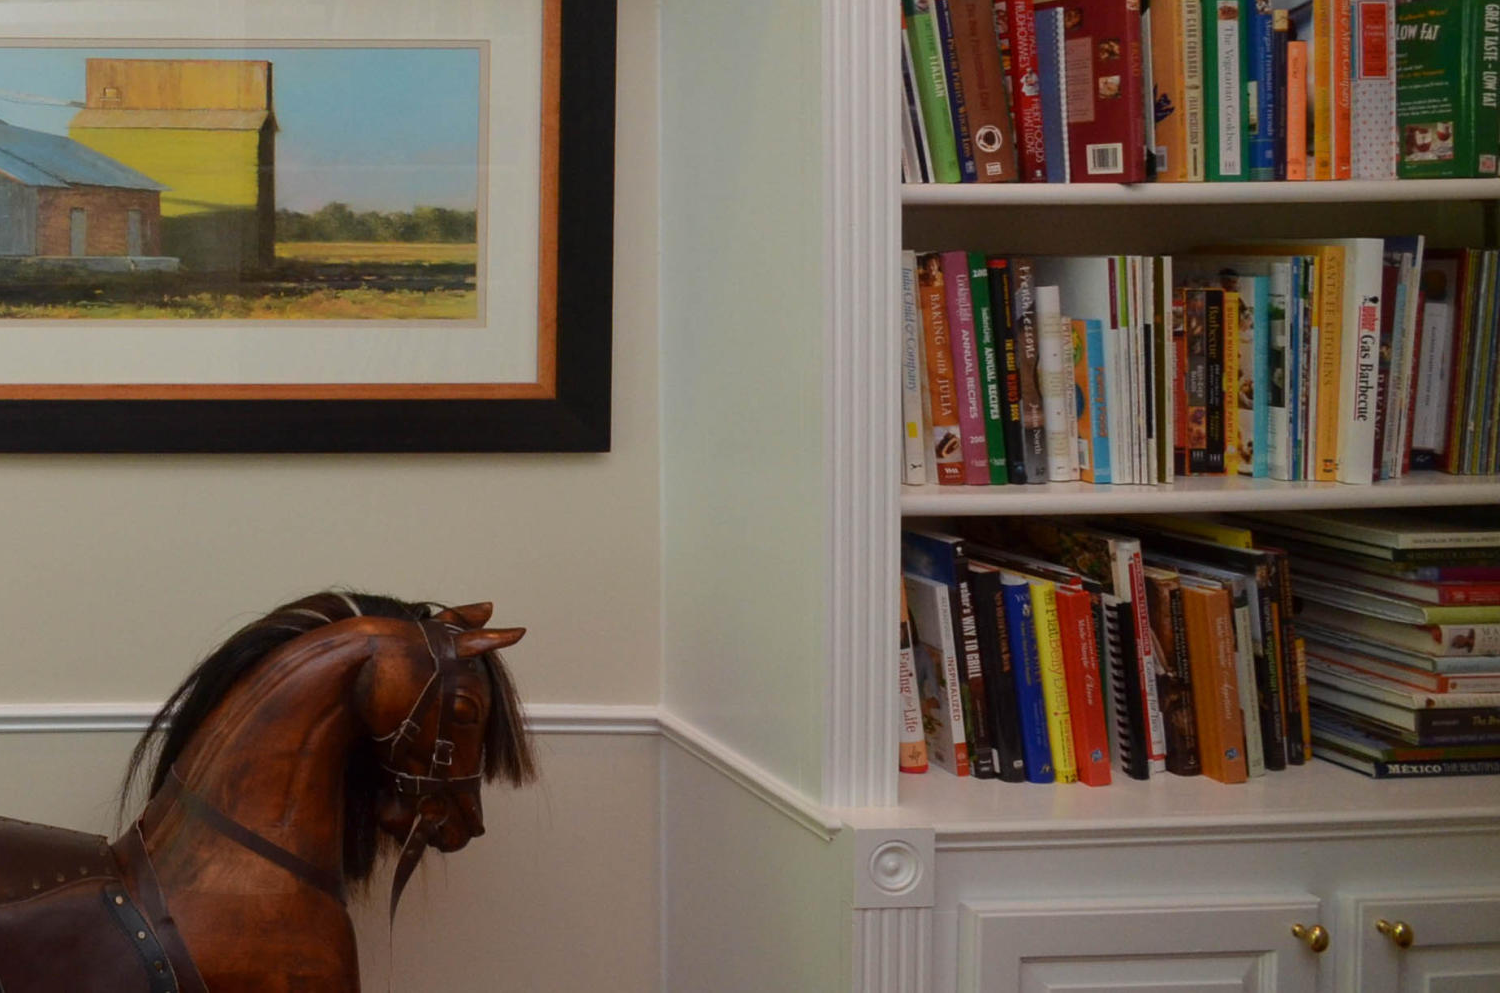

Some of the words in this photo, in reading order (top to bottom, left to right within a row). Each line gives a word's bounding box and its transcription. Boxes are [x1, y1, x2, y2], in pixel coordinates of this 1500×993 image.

[1224, 27, 1235, 46] The
[1396, 23, 1419, 41] LOW
[1420, 21, 1441, 42] FAT
[1484, 3, 1500, 35] GREAT
[1342, 30, 1352, 56] More
[1484, 37, 1499, 63] TASTE
[929, 54, 947, 98] ITALIAN
[1221, 48, 1236, 102] Vegetarian
[1340, 57, 1353, 108] Company
[1482, 70, 1498, 89] LOW
[1481, 90, 1497, 108] FAT
[1034, 125, 1046, 163] FOODS
[1325, 255, 1338, 296] SANTA
[930, 294, 946, 346] BAKING
[1324, 300, 1336, 317] FE
[1022, 313, 1038, 359] Lessons
[1207, 306, 1222, 359] Barbecue
[1361, 333, 1374, 354] Gas
[903, 338, 918, 393] Company
[935, 350, 948, 375] with
[961, 329, 976, 375] ANNUAL
[983, 347, 996, 381] ANNUAL
[1323, 322, 1337, 388] KITCHENS
[938, 378, 953, 417] JULIA
[965, 377, 979, 420] RECIPES
[987, 384, 1000, 420] RECIPES
[1356, 363, 1377, 422] Barbecue
[1033, 429, 1044, 455] North
[959, 582, 971, 615] weber's
[961, 616, 975, 638] WAY
[965, 638, 977, 652] TO
[967, 653, 981, 680] GRILL
[1264, 635, 1278, 693] vegetarian
[947, 656, 961, 723] INSPIRALIZED
[903, 709, 918, 734] Life
